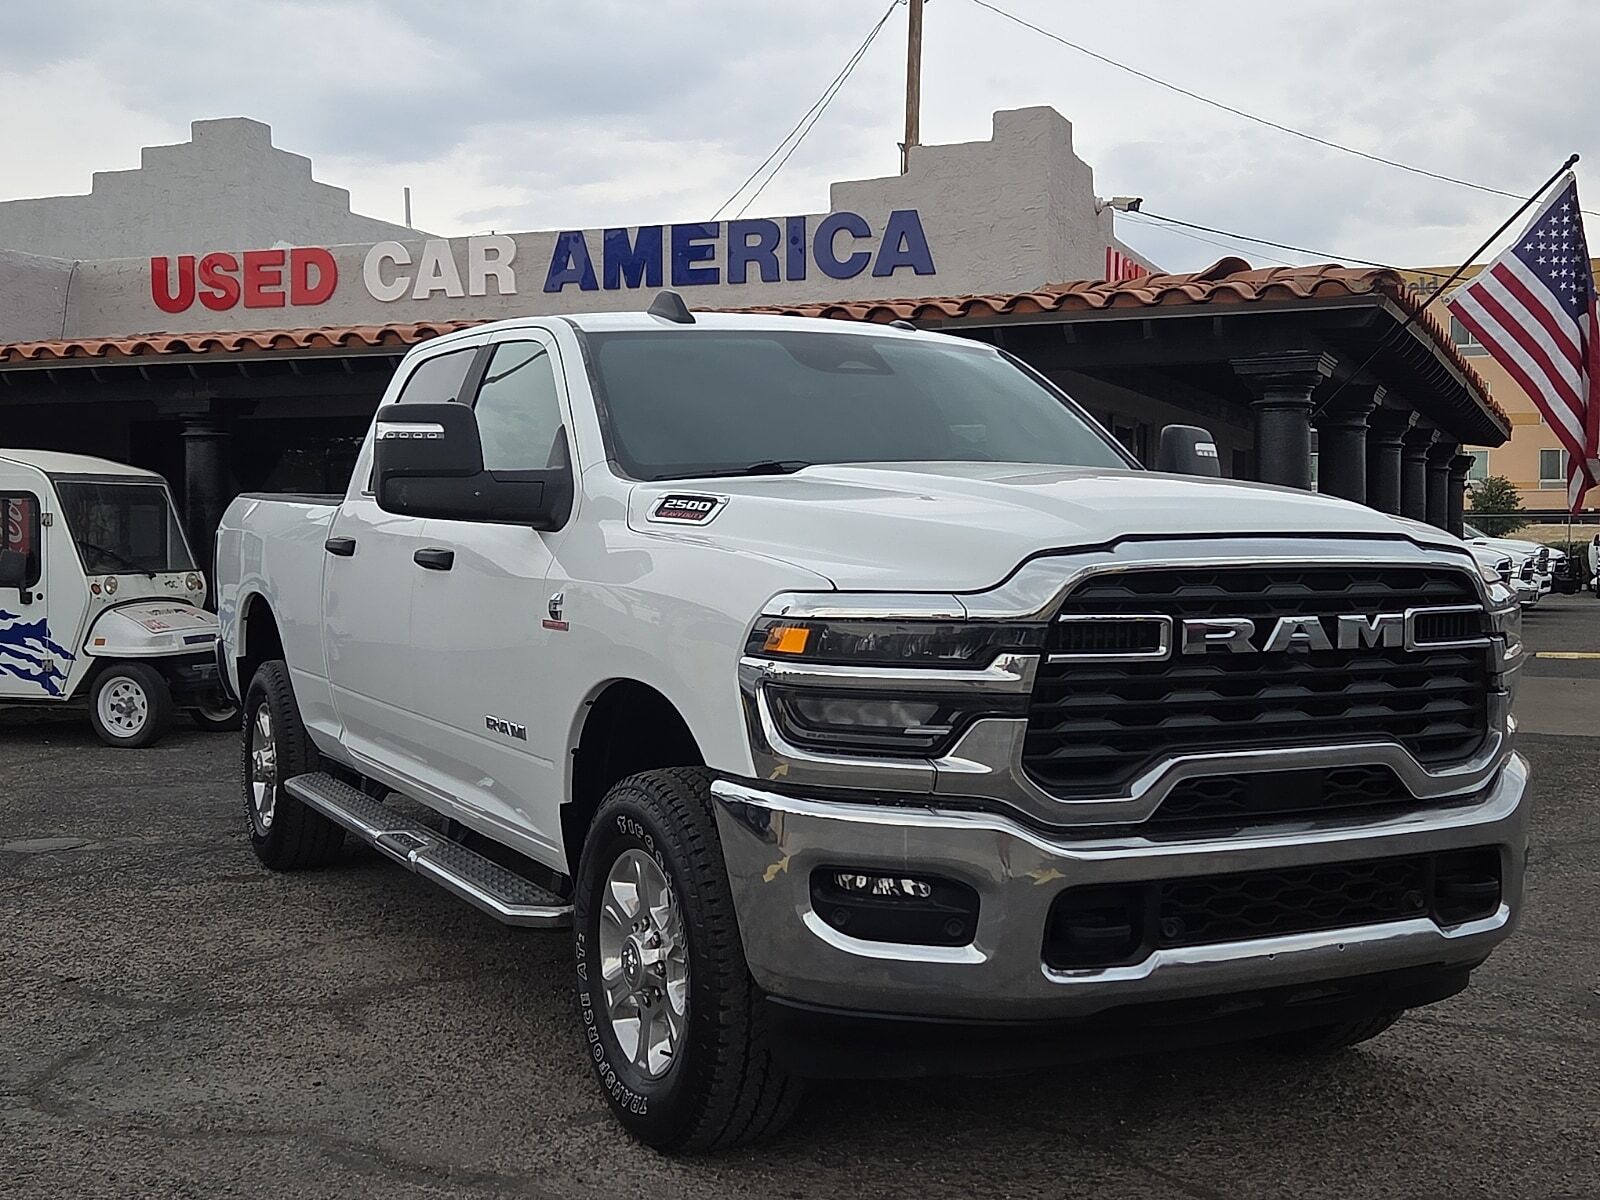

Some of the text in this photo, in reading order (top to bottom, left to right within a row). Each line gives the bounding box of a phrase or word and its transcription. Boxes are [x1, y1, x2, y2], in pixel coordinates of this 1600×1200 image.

[150, 208, 937, 313] USED CAR AMERICA
[664, 499, 712, 511] 2500
[1182, 613, 1404, 655] RAM
[485, 714, 528, 741] RAM
[579, 991, 648, 1116] TRANSFORCE
